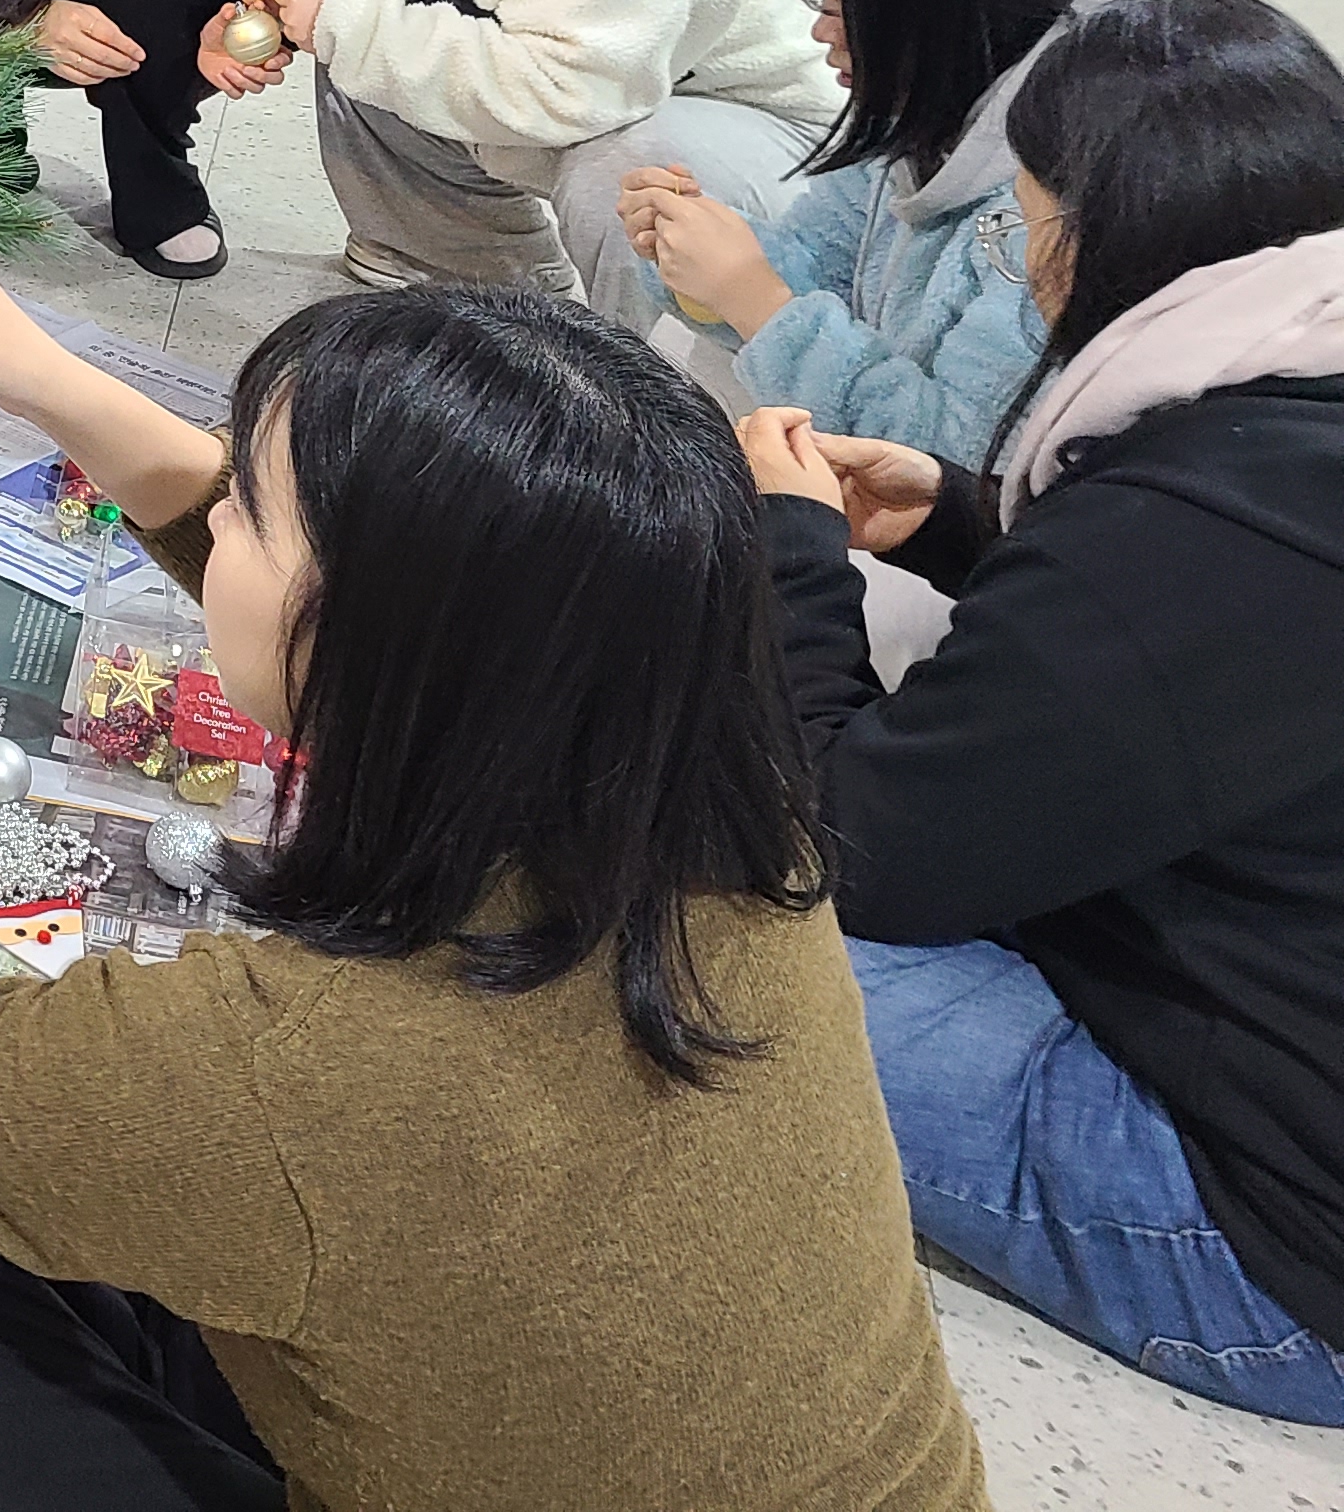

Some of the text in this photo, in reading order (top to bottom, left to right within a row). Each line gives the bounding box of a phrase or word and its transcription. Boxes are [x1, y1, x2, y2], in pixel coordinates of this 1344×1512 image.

[198, 691, 231, 708] Christ
[210, 705, 231, 719] Tree
[193, 713, 247, 734] Decoration
